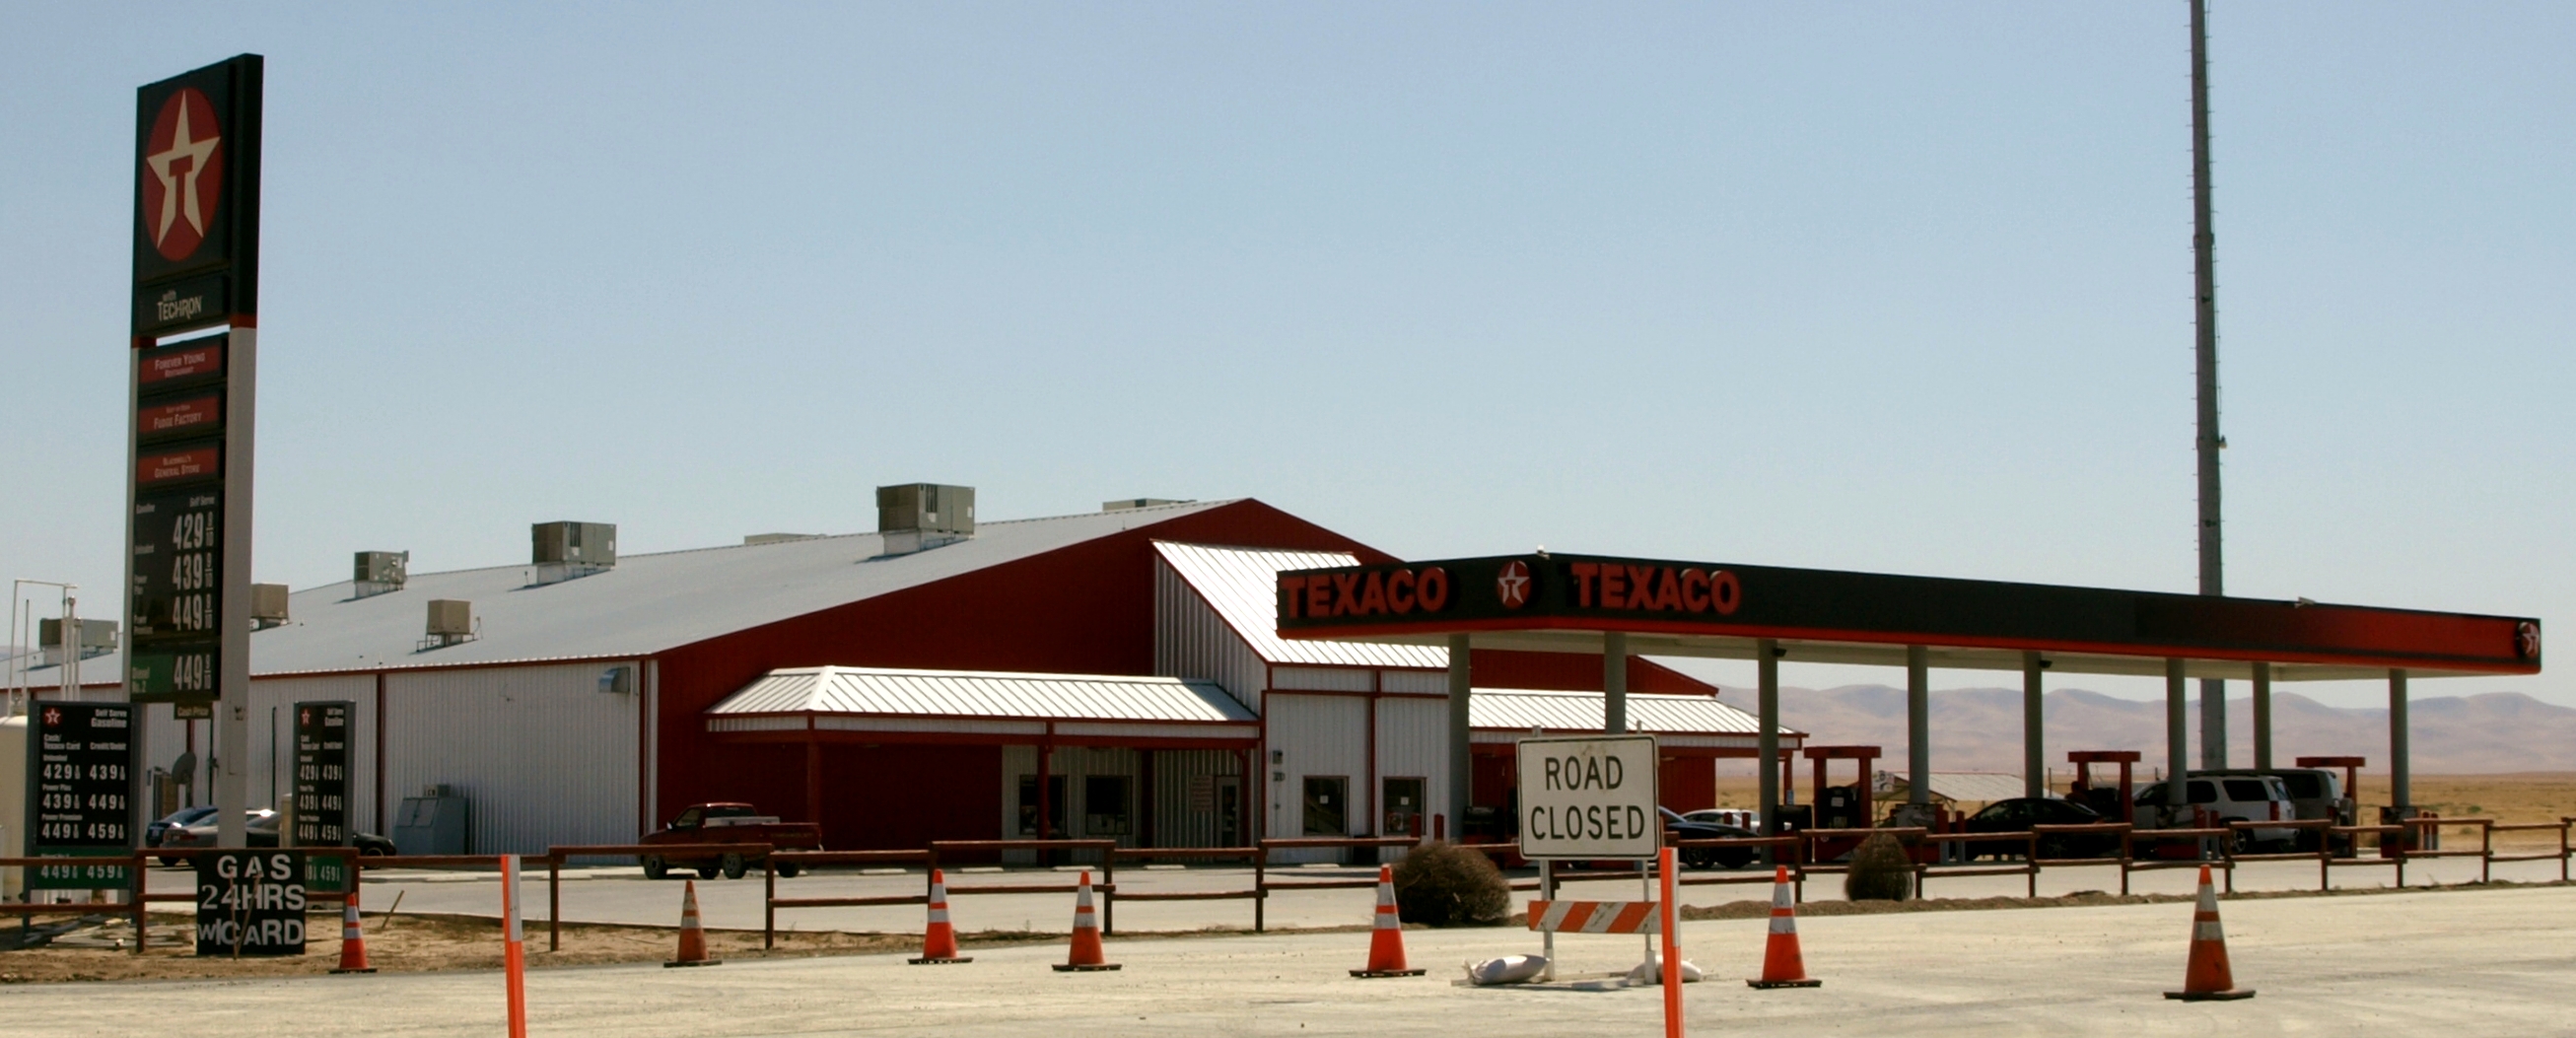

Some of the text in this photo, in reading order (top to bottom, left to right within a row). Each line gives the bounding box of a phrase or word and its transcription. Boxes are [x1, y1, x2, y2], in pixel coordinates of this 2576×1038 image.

[157, 296, 202, 322] TECHRON
[173, 512, 204, 550] 429
[173, 552, 203, 590] 439
[1570, 563, 1742, 615] TEXACO
[1281, 567, 1449, 620] TEXACO
[173, 593, 203, 632] 449
[174, 654, 203, 691] 449
[1545, 755, 1623, 791] ROAD
[1531, 804, 1644, 840] CLOSED
[217, 854, 292, 880] GAS
